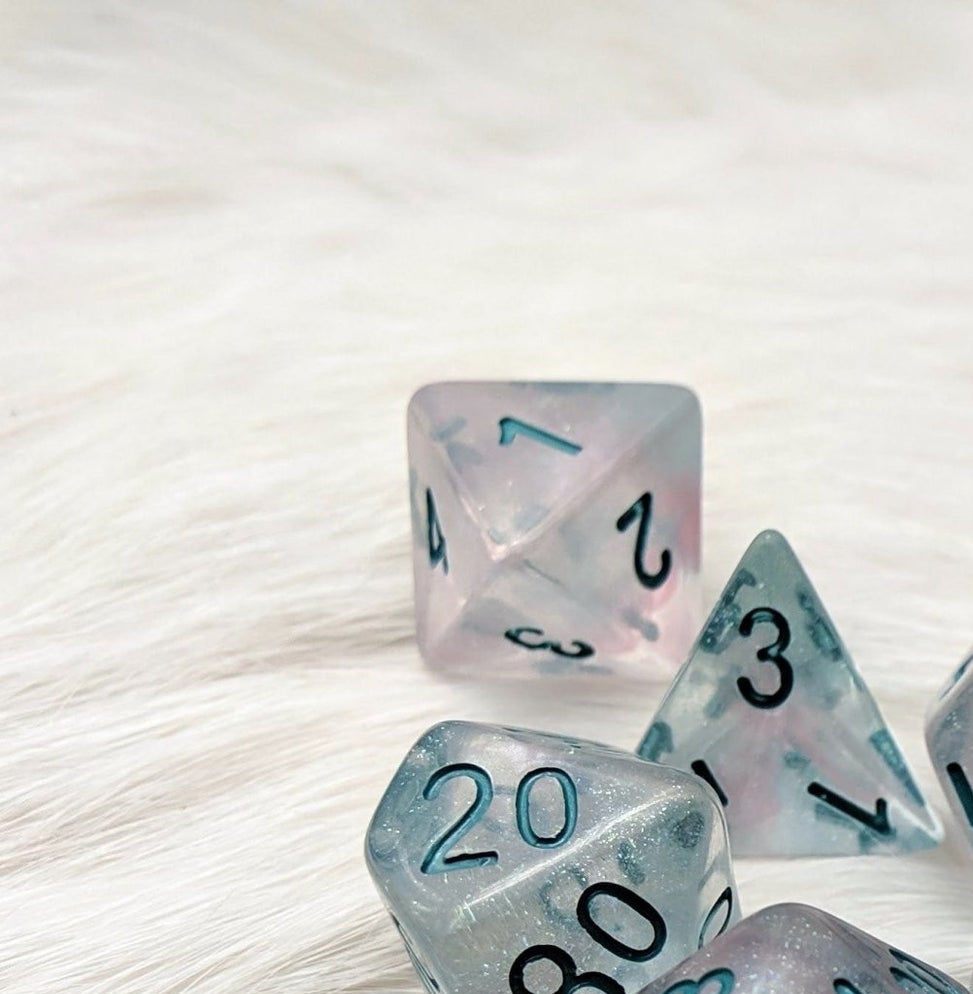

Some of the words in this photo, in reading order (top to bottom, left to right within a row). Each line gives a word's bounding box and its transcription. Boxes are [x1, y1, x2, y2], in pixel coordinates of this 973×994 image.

[498, 415, 583, 456] 1
[425, 487, 449, 576] 4
[616, 491, 672, 590] 2
[504, 627, 595, 660] 3
[736, 606, 794, 709] 3
[420, 763, 578, 875] 20
[807, 781, 897, 838] 1
